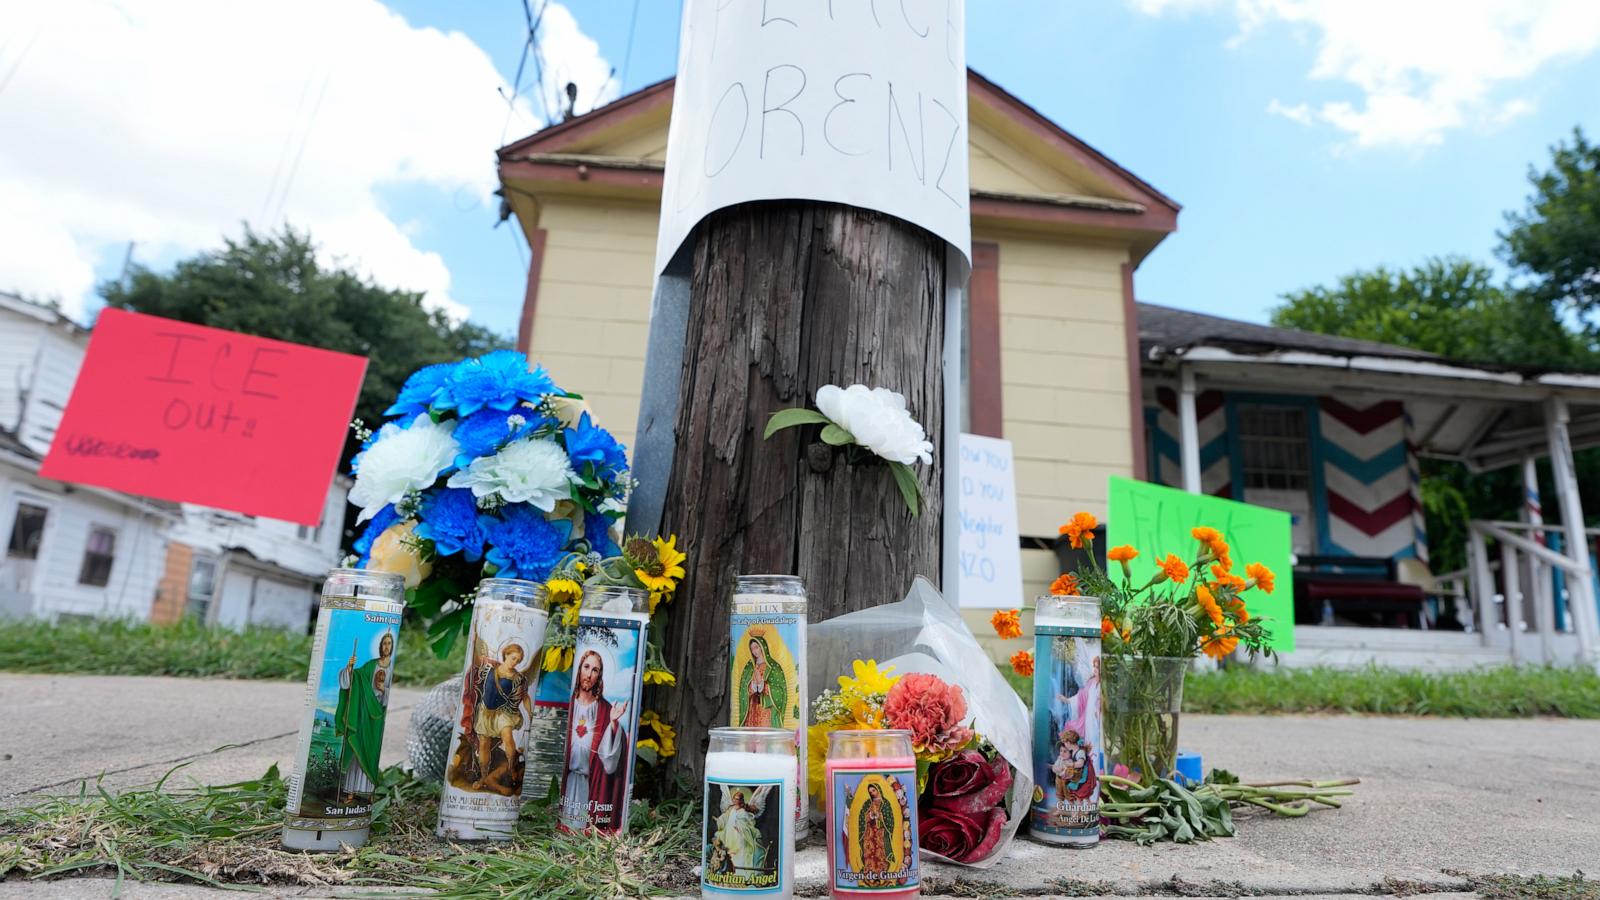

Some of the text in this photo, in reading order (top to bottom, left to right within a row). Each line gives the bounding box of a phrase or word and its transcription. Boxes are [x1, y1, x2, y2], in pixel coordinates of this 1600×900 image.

[144, 331, 289, 401] ICE
[960, 446, 1008, 472] OW YOU
[980, 480, 1005, 502] YOU
[365, 613, 386, 623] Saint
[752, 616, 760, 624] of
[761, 616, 797, 626] Guadalupe
[325, 806, 343, 815] San
[344, 804, 366, 815] Judas
[583, 800, 593, 811] of
[593, 801, 613, 813] Jesus
[1056, 800, 1096, 812] Guardian
[1059, 814, 1079, 825] Angel
[1081, 815, 1089, 823] De
[704, 870, 777, 885] Guardian Angel
[838, 869, 865, 882] Virgen
[866, 870, 878, 880] de
